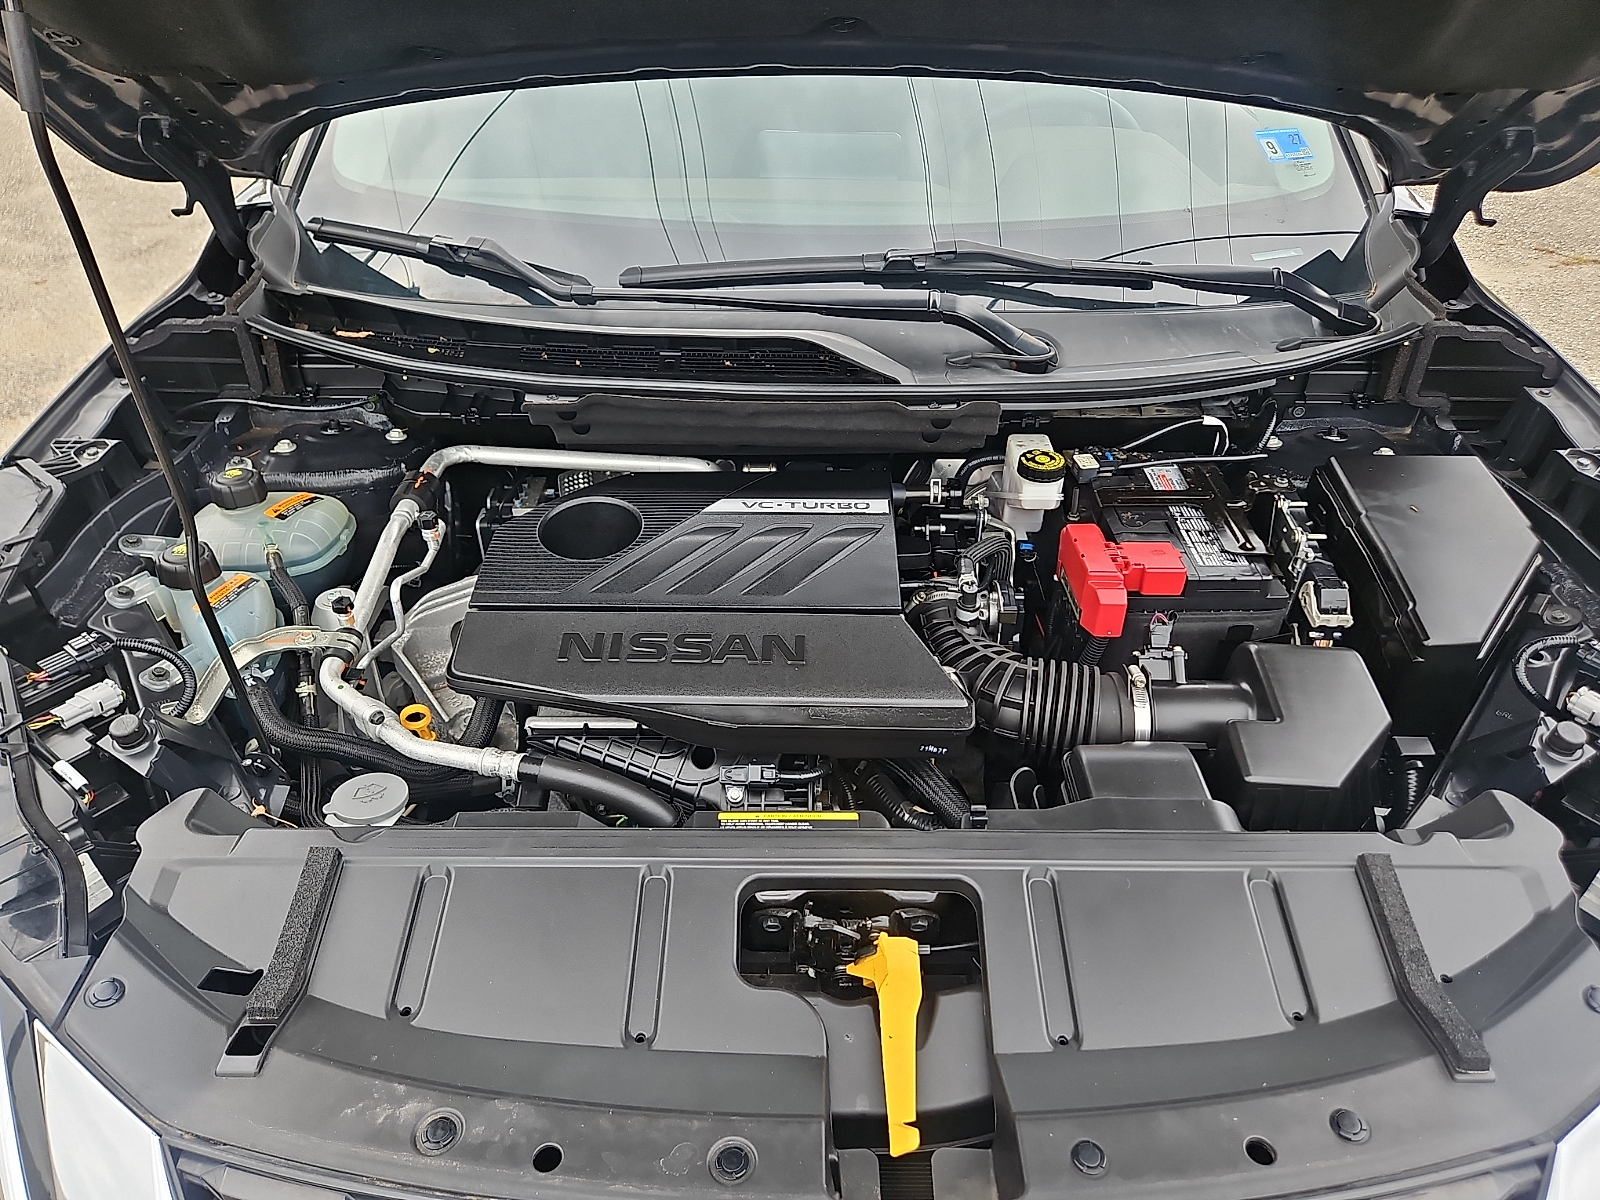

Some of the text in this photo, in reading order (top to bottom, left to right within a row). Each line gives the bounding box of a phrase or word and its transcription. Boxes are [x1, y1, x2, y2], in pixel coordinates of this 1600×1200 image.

[1288, 133, 1302, 145] 27
[1265, 140, 1279, 155] 9
[741, 501, 871, 510] VC-TURBO
[556, 631, 806, 665] NISSAN
